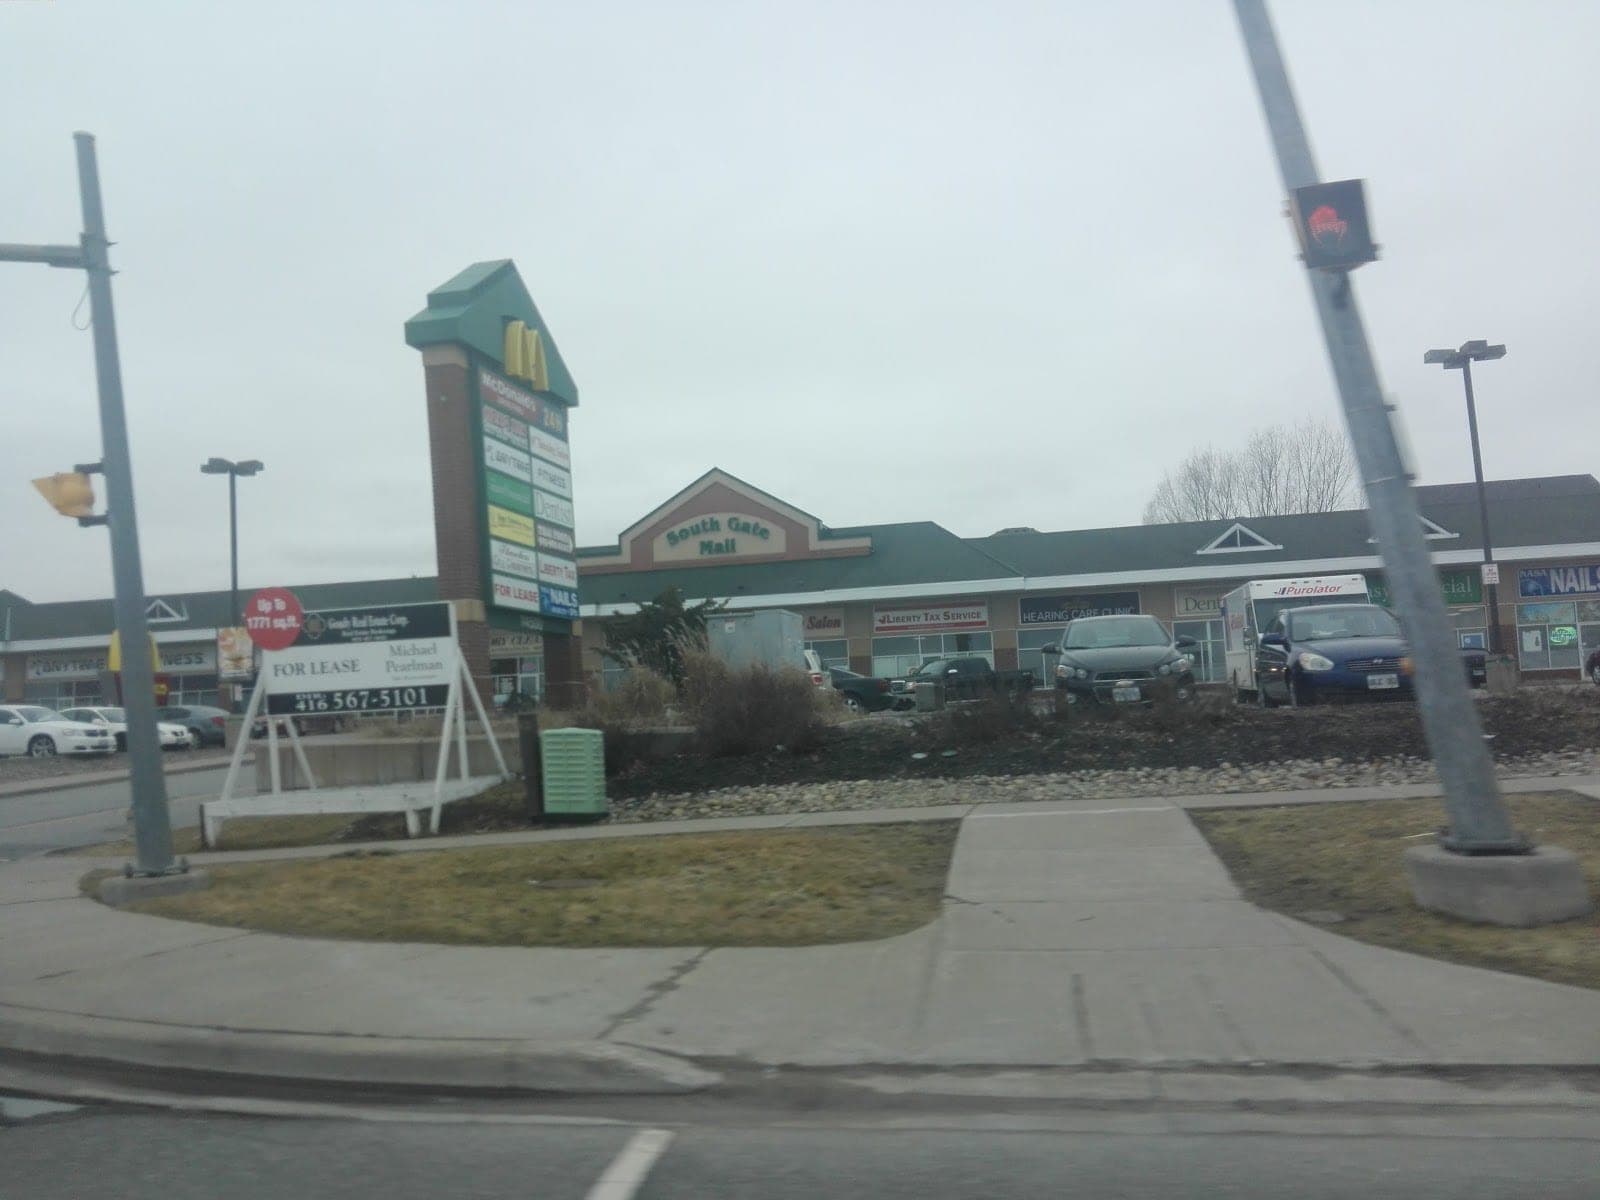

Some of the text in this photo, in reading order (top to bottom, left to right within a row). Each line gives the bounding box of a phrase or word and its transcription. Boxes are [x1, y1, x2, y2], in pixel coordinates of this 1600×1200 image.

[482, 372, 537, 412] McDonald's
[535, 490, 574, 524] Dentist
[666, 516, 770, 547] South Gate
[699, 538, 736, 555] Mall
[1286, 584, 1342, 596] Purolator
[1441, 575, 1472, 594] cial
[495, 583, 511, 597] FOR
[513, 586, 539, 603] LEASE
[550, 587, 577, 608] NAILS
[257, 598, 273, 613] Up
[1184, 596, 1221, 612] Dent
[246, 616, 270, 629] 1771
[806, 615, 842, 630] Salon
[886, 614, 922, 625] LIBERTY
[943, 610, 982, 622] SERVICE
[1023, 609, 1069, 623] HEARING
[1071, 608, 1099, 619] CARE
[390, 642, 437, 657] Michael
[162, 652, 205, 668] NESS
[273, 658, 361, 678] FOR LEASE
[385, 659, 443, 673] Pearlman
[295, 698, 328, 711] 416
[333, 688, 428, 710] 567-5101
